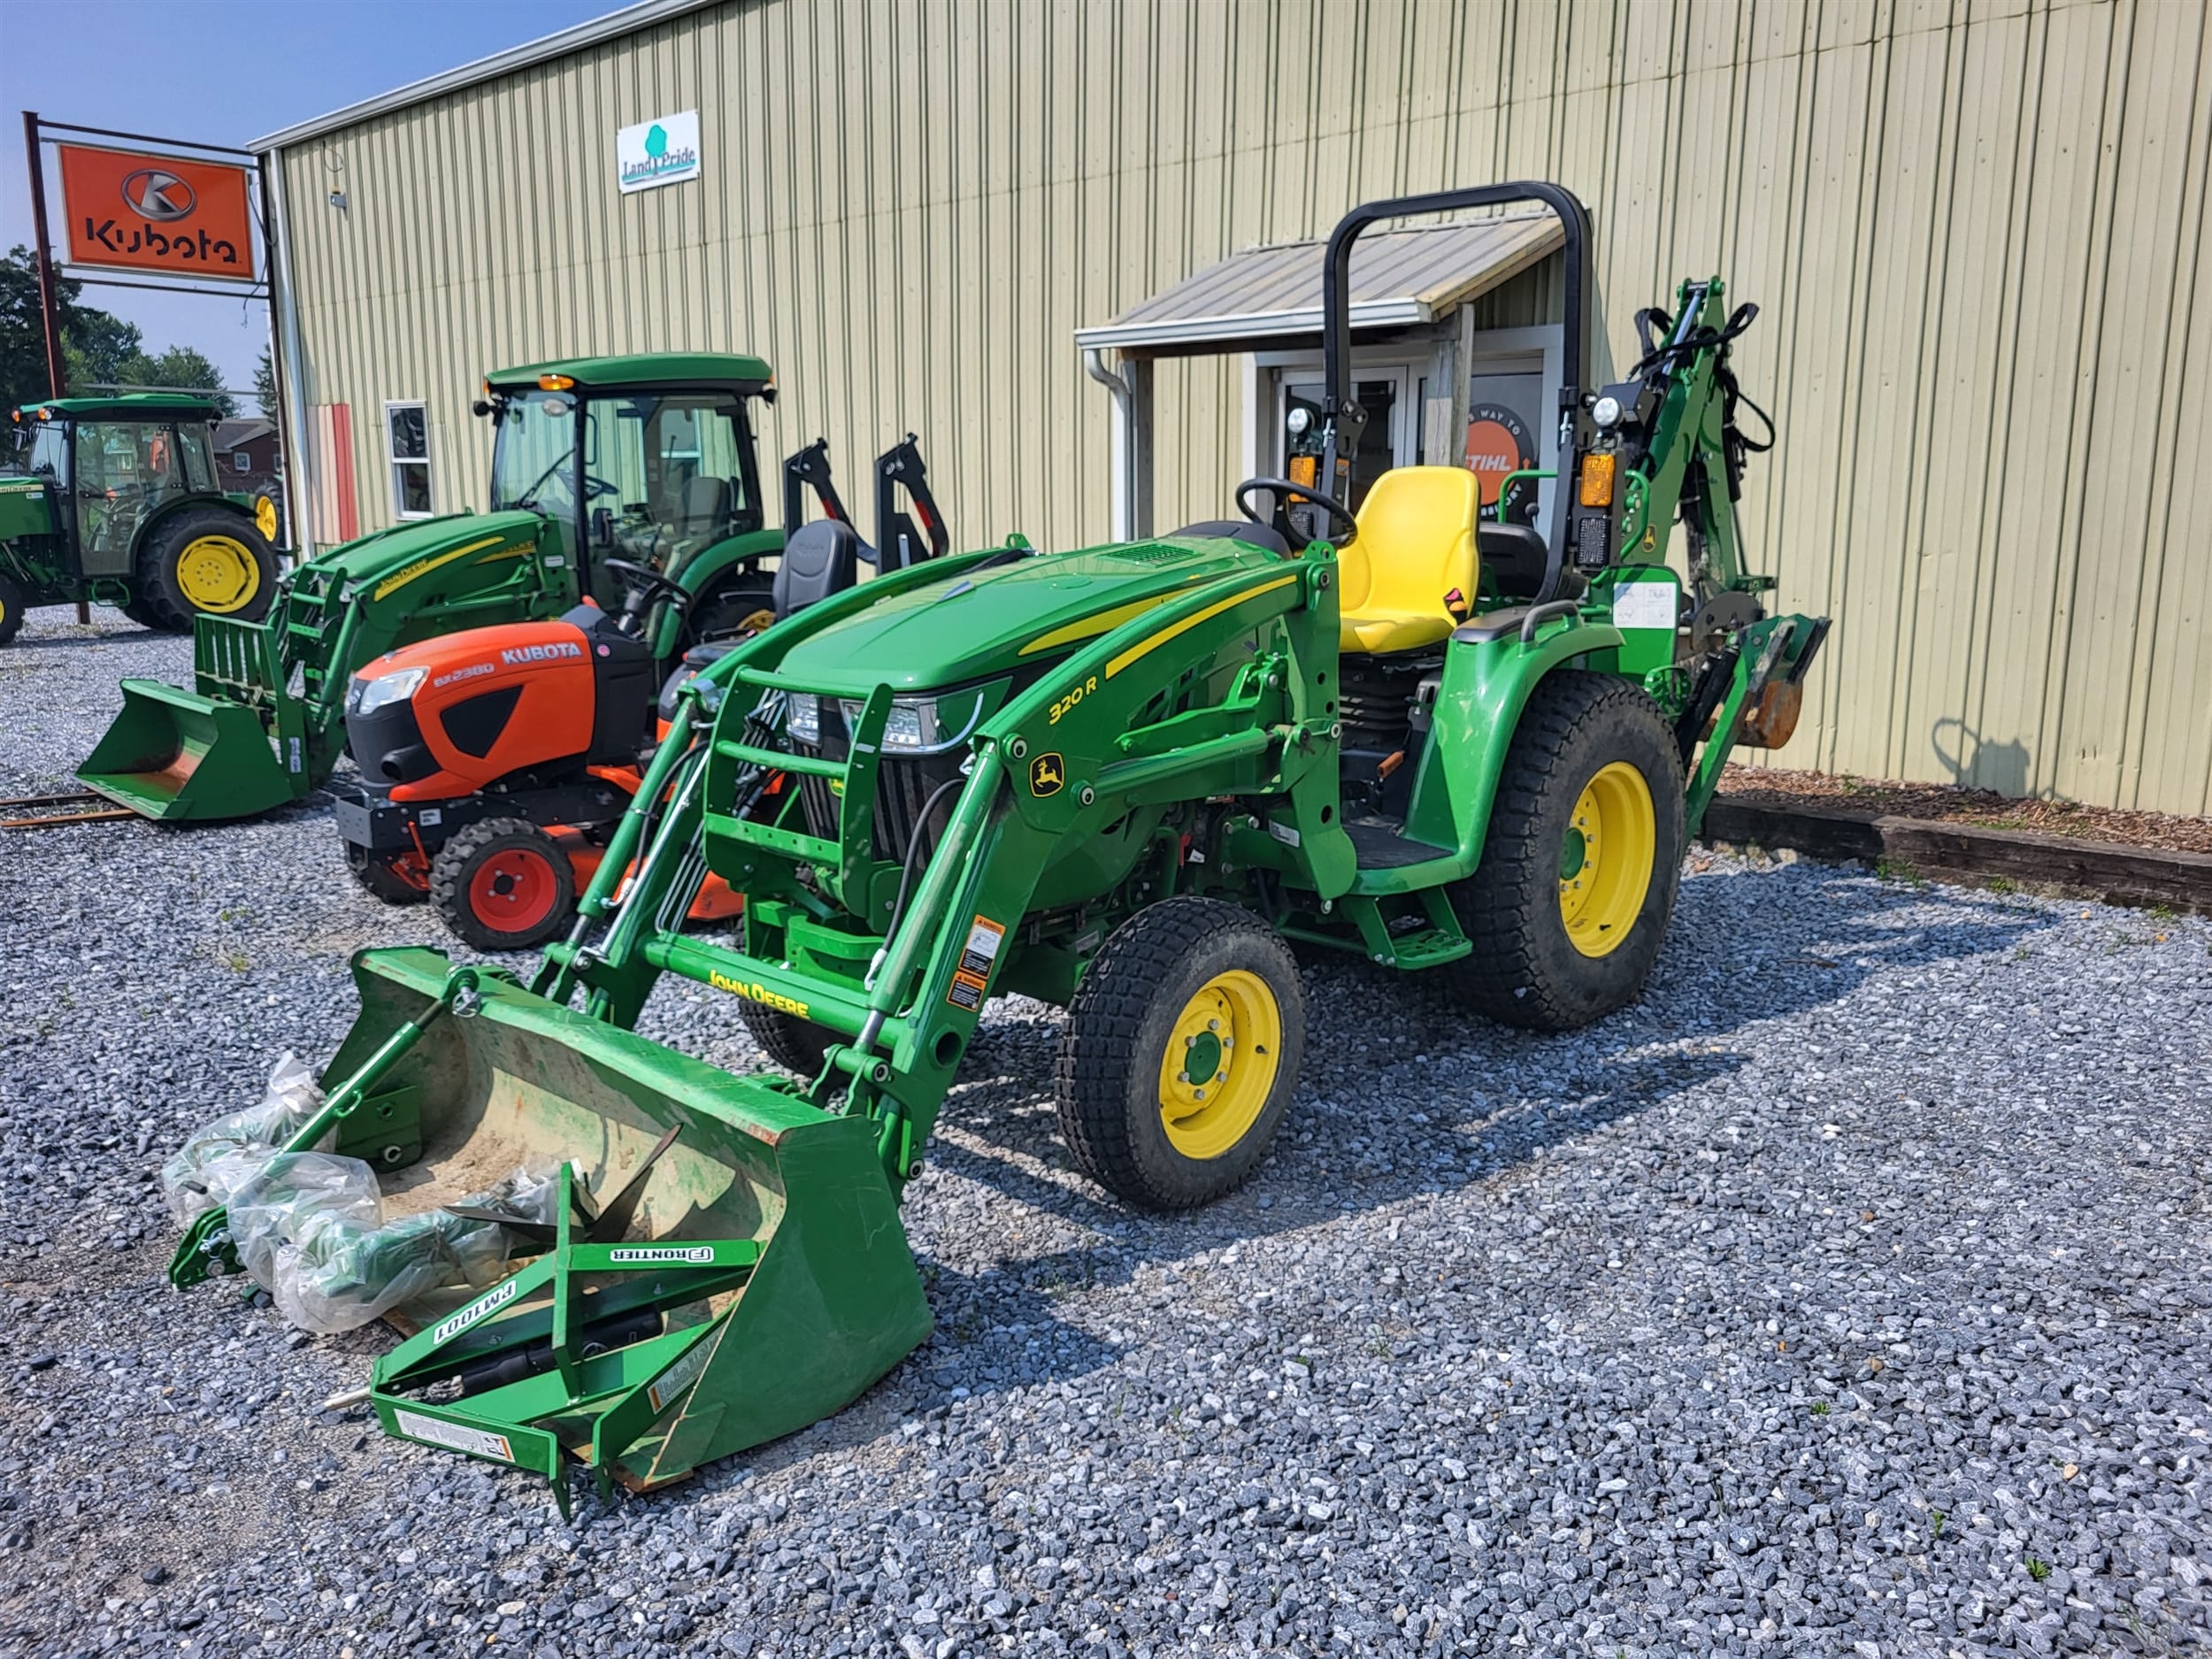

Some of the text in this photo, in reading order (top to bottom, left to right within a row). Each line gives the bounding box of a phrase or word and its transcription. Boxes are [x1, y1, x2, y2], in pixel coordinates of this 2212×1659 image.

[623, 147, 695, 177] Land Pride
[85, 217, 237, 264] Kubota
[1480, 410, 1504, 421] WAY
[1508, 419, 1521, 435] TO
[1465, 454, 1511, 472] TIHL
[501, 641, 582, 665] KUBOTA
[434, 663, 495, 687] BX2380
[1048, 676, 1096, 726] 320 R
[709, 969, 810, 1020] JOHN DEERE
[613, 1247, 710, 1261] FRONTIER
[437, 1284, 513, 1340] PM1001
